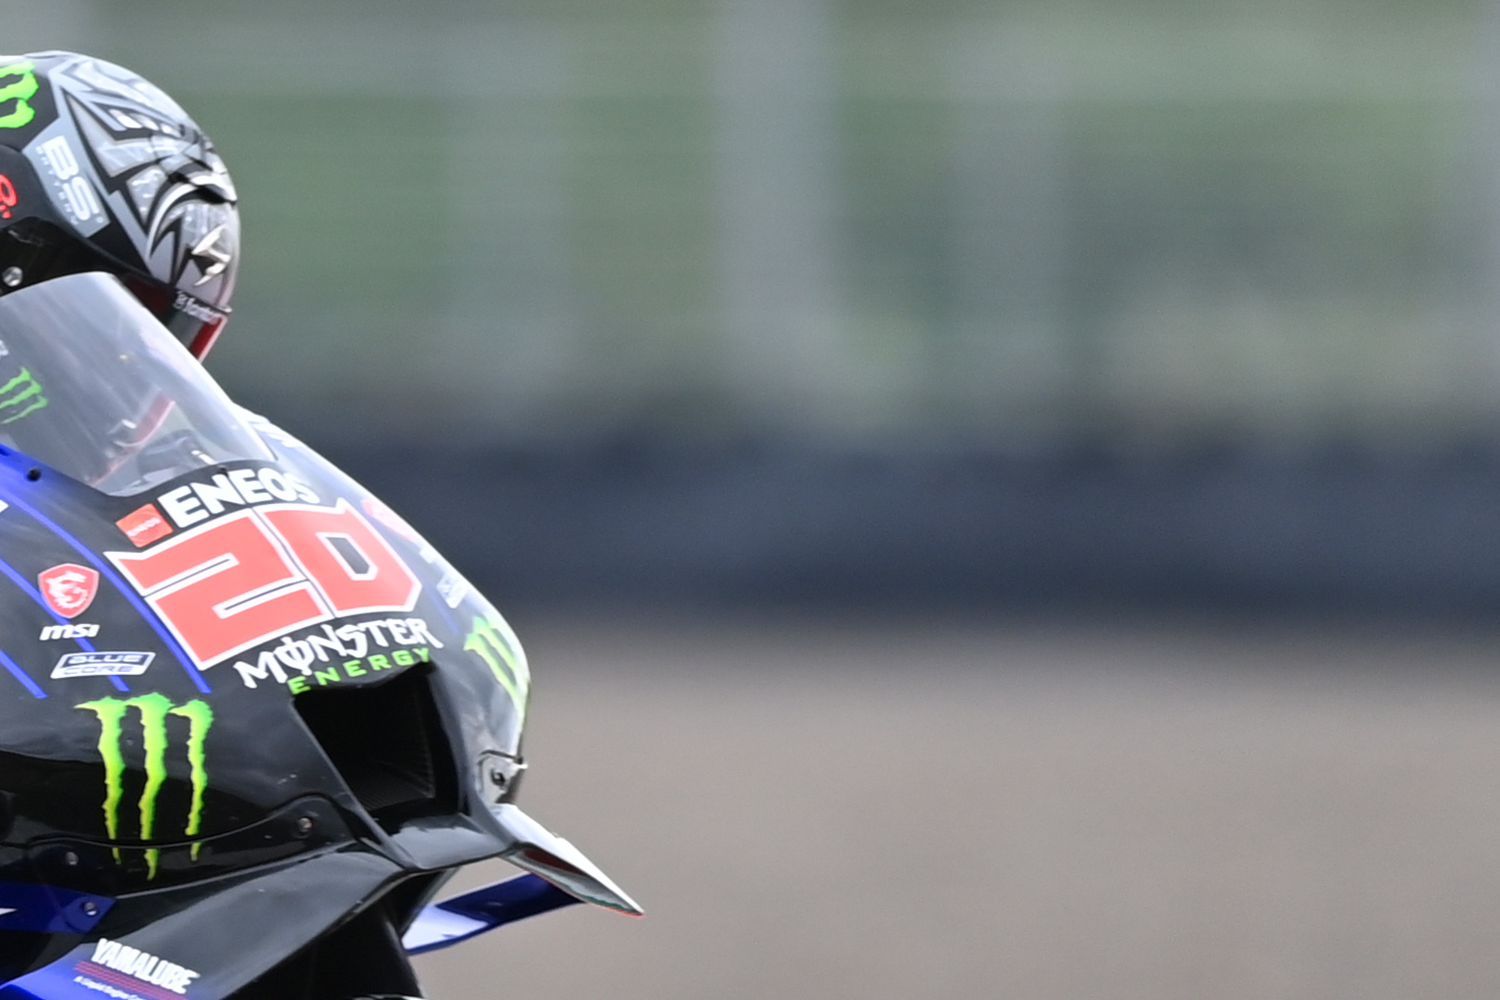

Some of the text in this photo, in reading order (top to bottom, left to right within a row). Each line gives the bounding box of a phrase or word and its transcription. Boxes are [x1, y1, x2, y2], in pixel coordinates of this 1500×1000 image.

[157, 467, 320, 528] ENEOS
[103, 498, 422, 671] 20
[63, 666, 135, 676] CORE
[68, 654, 143, 664] BLUE
[234, 617, 443, 689] MONSTER
[287, 648, 430, 695] ENERGY
[91, 938, 200, 994] YAMALUBE
